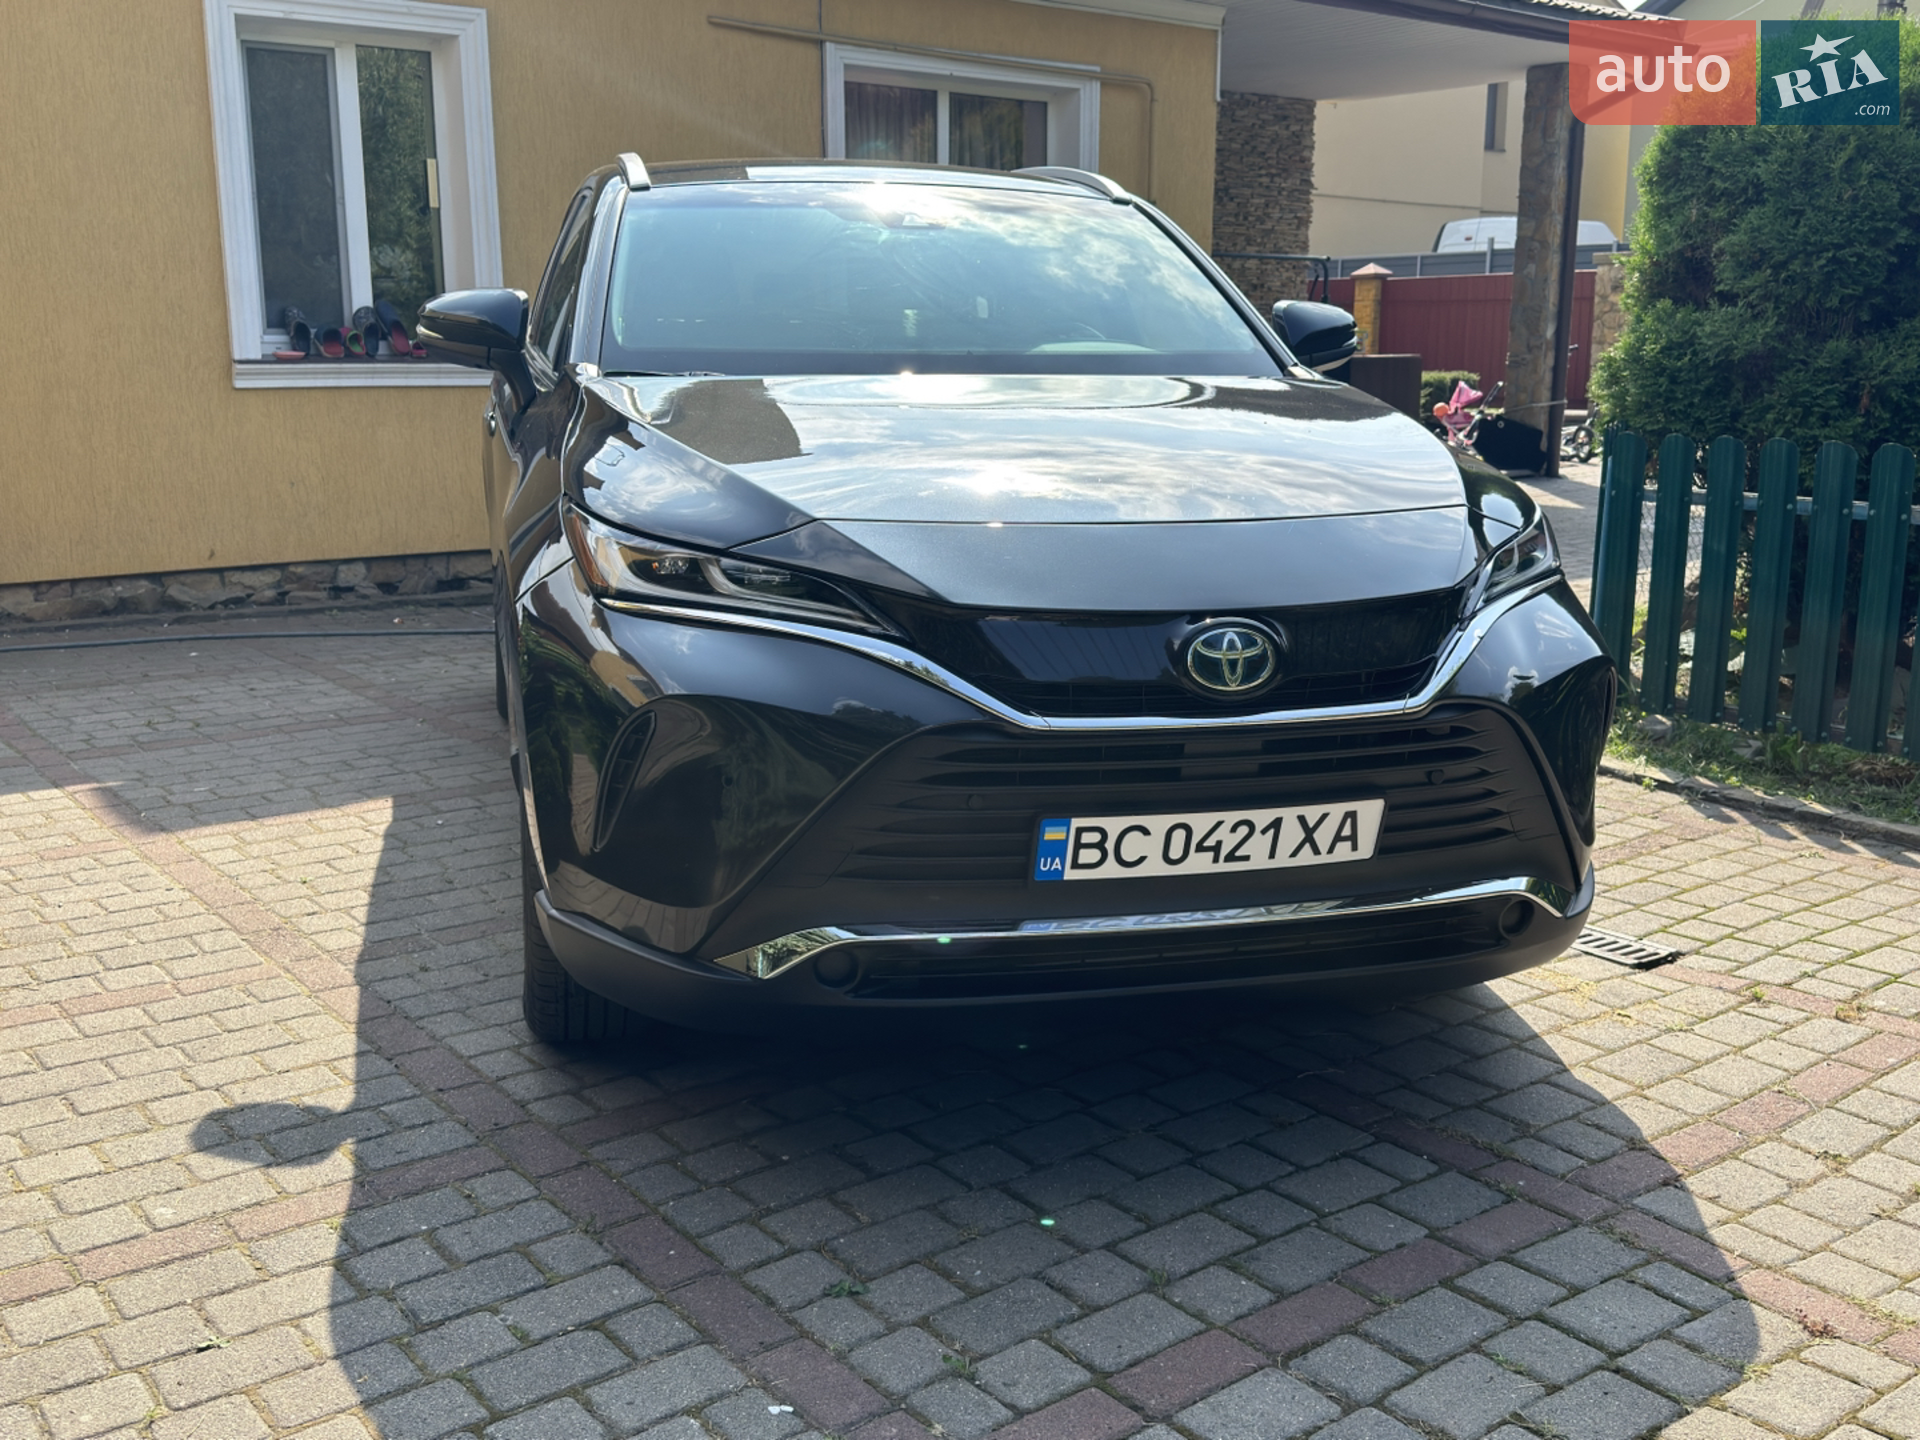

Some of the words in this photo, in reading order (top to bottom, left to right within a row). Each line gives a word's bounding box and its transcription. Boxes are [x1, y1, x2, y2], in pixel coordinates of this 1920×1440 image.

[1070, 824, 1151, 870] BC
[1161, 817, 1284, 866] 0421
[1289, 810, 1359, 860] XA
[1040, 857, 1062, 872] UA
